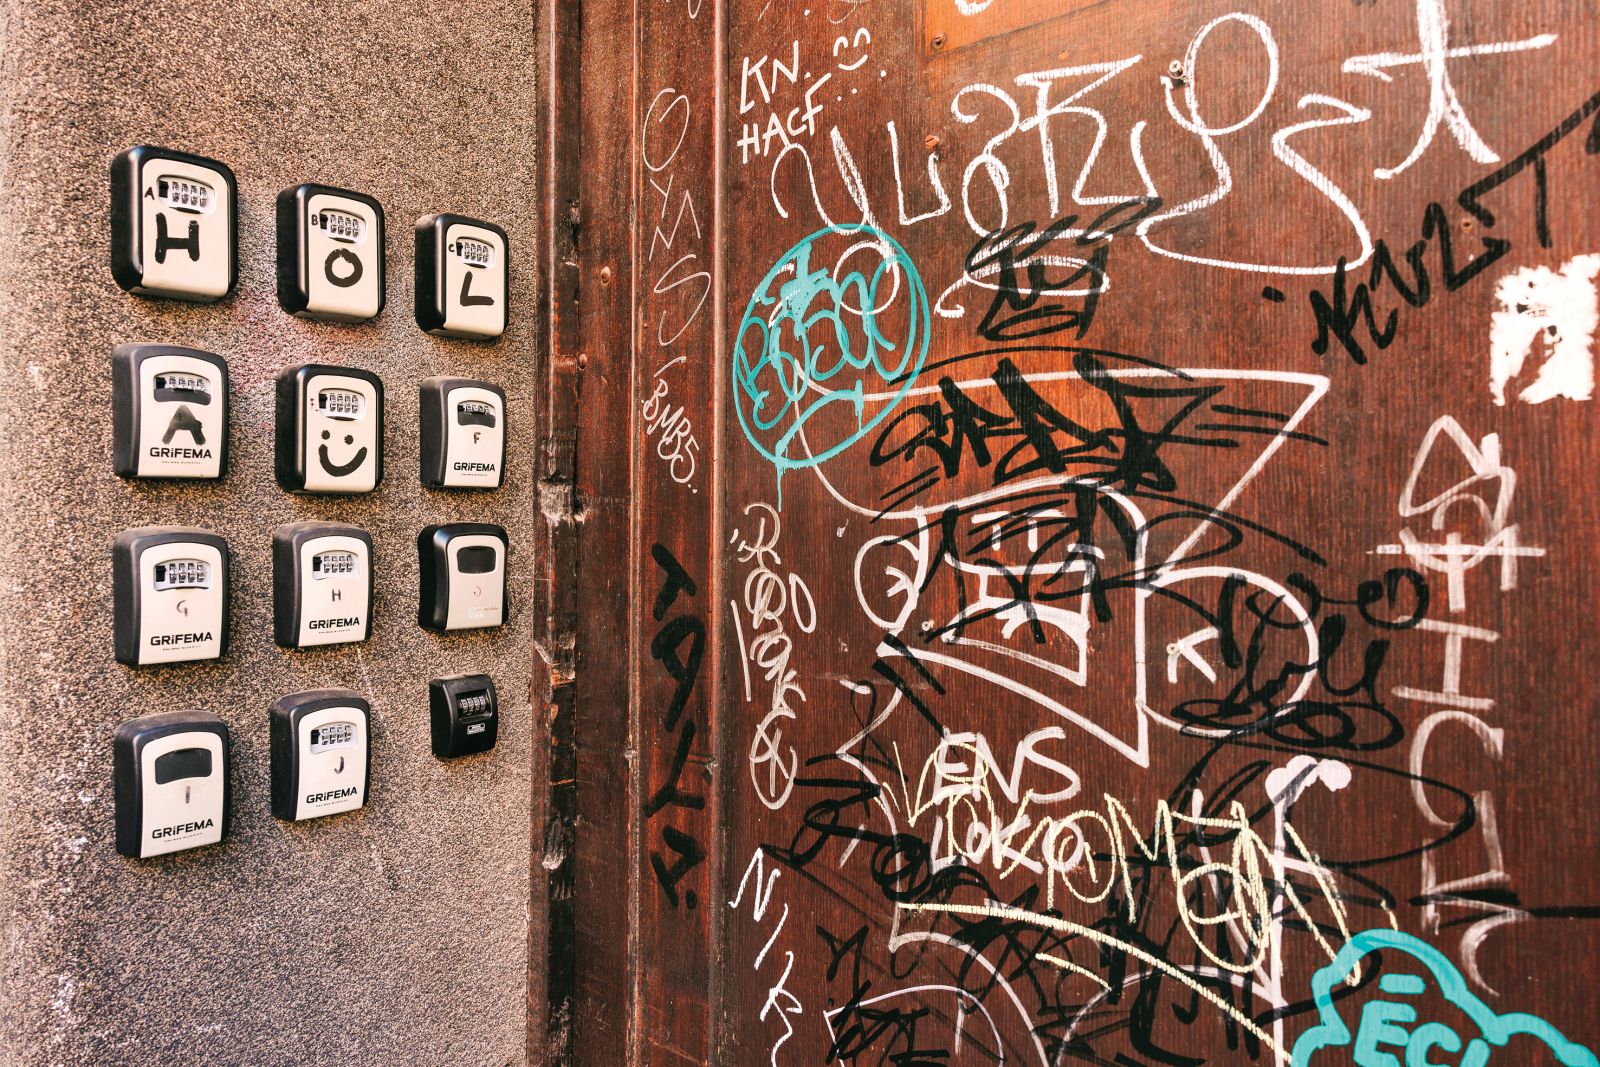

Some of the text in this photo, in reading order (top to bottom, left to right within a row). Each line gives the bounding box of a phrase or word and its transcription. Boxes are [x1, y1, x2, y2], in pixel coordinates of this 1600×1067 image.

[144, 186, 155, 200] A
[311, 214, 318, 226] B
[155, 212, 200, 264] H
[448, 243, 455, 253] C
[324, 248, 363, 288] O
[460, 271, 494, 306] L
[162, 404, 206, 445] A
[473, 432, 482, 444] F
[332, 589, 342, 602] H
[333, 756, 345, 774] J
